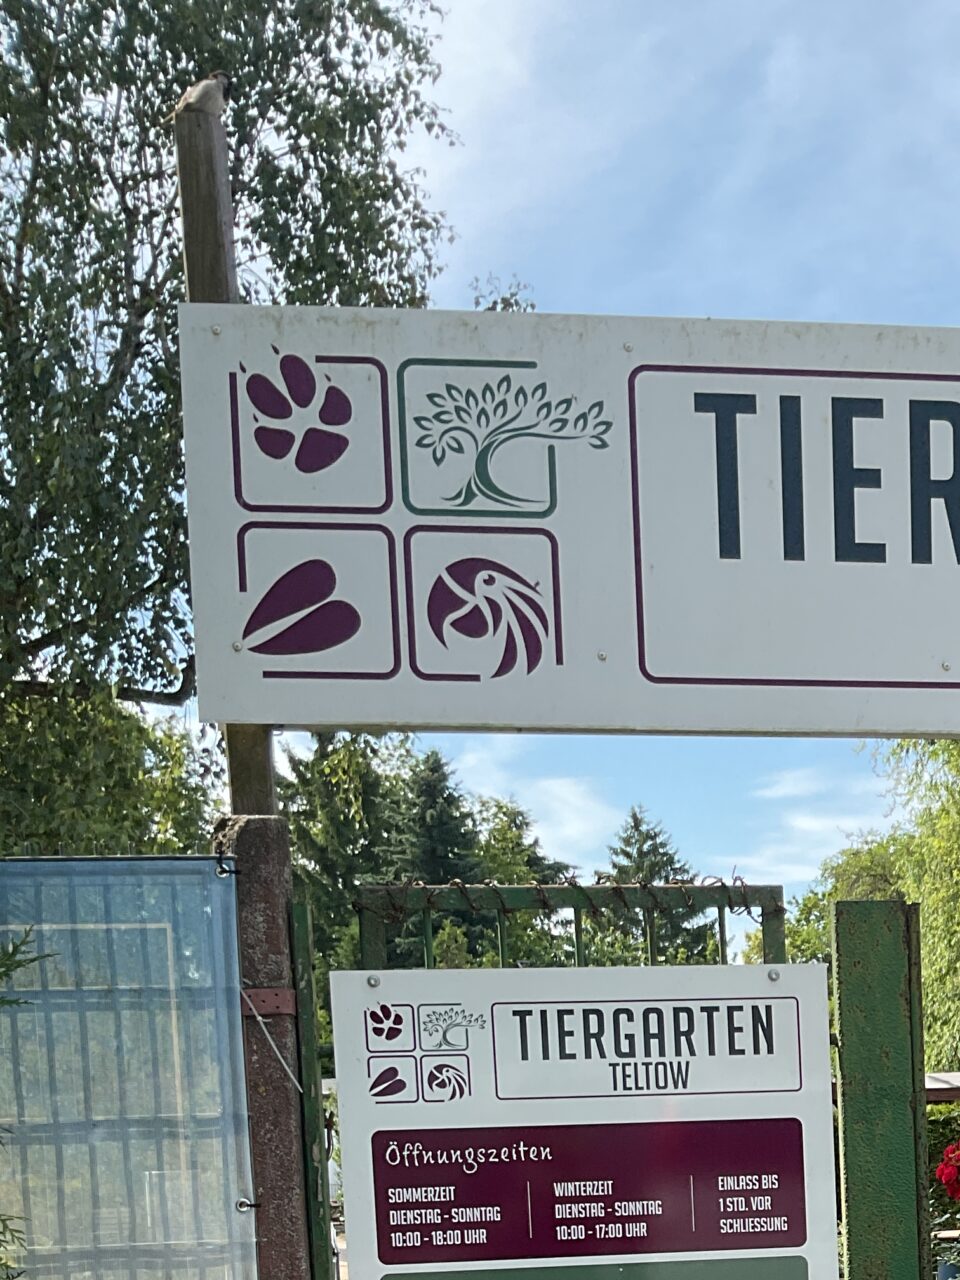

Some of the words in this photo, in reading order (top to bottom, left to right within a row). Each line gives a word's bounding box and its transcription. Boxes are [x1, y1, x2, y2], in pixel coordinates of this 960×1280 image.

[512, 1004, 774, 1061] TIERGARTEN
[609, 1061, 690, 1091] TELTOW
[386, 1141, 552, 1173] Öffnungszeiten
[553, 1181, 613, 1197] WINTERZEIT
[718, 1175, 759, 1191] EINLASS
[761, 1175, 778, 1189] BIS
[388, 1186, 455, 1203] SOMMERZEIT
[555, 1203, 605, 1219] DIENSTAG
[615, 1201, 662, 1216] SONNTAG
[719, 1199, 724, 1212] 1
[726, 1198, 748, 1211] STD.
[750, 1196, 772, 1210] VOR
[389, 1209, 441, 1225] DIENSTAG
[451, 1207, 501, 1223] SONNTAG
[720, 1217, 788, 1233] SCHLIESSUNG
[390, 1232, 421, 1247] 10:00
[431, 1230, 461, 1245] 18:00
[464, 1229, 487, 1244] UHR
[556, 1225, 585, 1240] 10:00
[595, 1223, 622, 1239] 17:00
[626, 1222, 647, 1237] UHR
